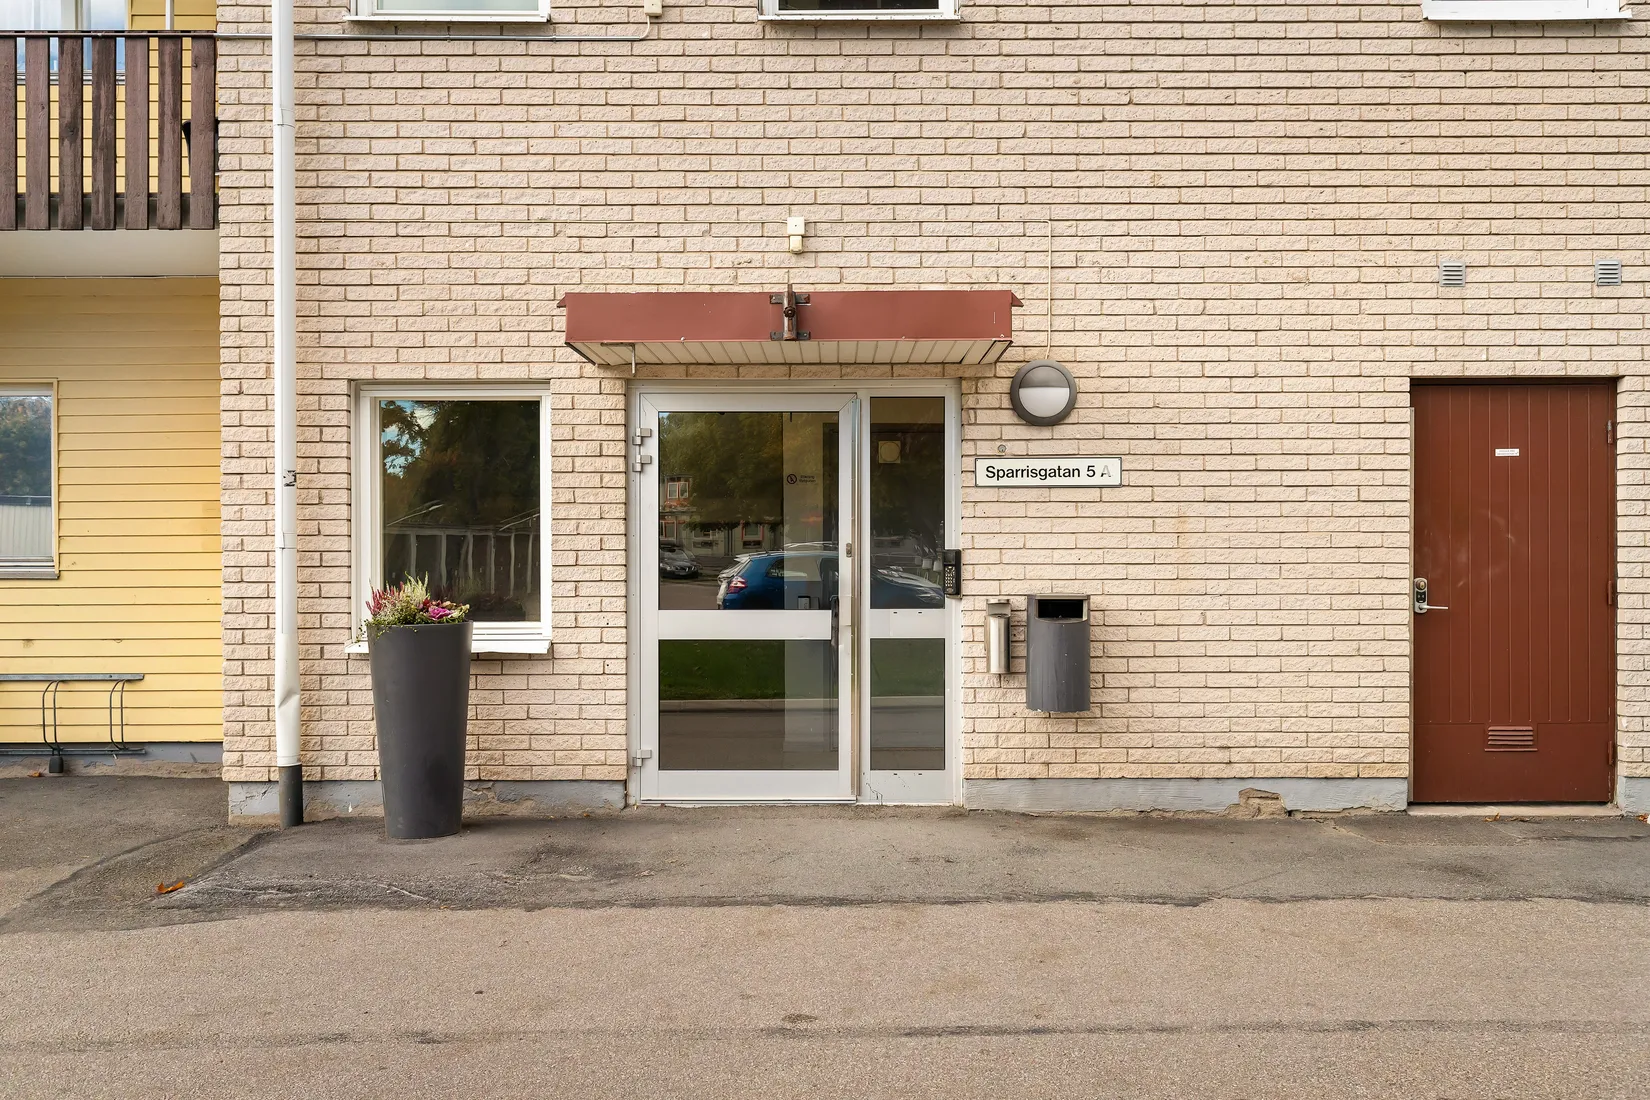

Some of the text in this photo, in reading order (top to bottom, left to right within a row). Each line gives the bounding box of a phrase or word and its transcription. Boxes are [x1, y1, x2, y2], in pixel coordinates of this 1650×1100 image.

[985, 465, 1111, 481] Sparrisgatan 5 A
